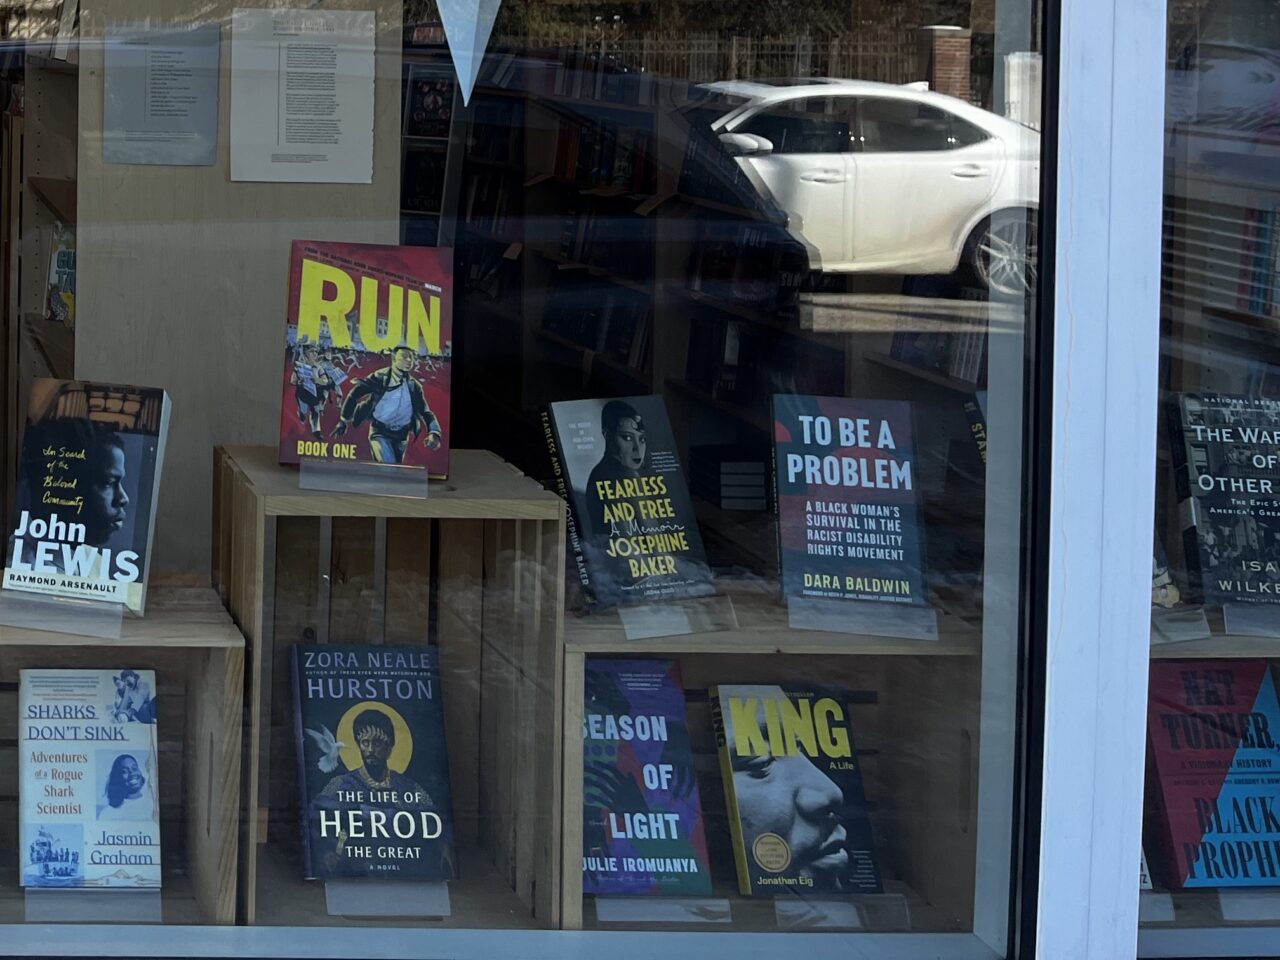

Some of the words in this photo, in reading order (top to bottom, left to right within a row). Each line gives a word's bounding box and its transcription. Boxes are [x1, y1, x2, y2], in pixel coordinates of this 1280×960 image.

[296, 258, 441, 355] RUN
[1204, 397, 1250, 405] NATIONAL
[798, 415, 832, 446] TO
[838, 417, 872, 448] BE
[877, 420, 897, 450] A
[1190, 425, 1234, 443] THE
[297, 440, 328, 457] BOOK
[332, 443, 357, 459] ONE
[1252, 454, 1278, 469] OF
[786, 453, 913, 491] PROBLEM
[596, 476, 668, 500] FEARLESS
[1198, 474, 1273, 494] OTHER
[603, 504, 635, 524] AND
[639, 498, 676, 520] FREE
[806, 500, 813, 512] A
[816, 501, 848, 514] BLACK
[851, 504, 901, 518] WOMAN'S
[14, 510, 86, 543] John
[551, 456, 561, 476] AND
[575, 556, 590, 586] BAKER
[626, 519, 685, 536] Memoir
[806, 516, 861, 530] SURVIVAL
[864, 517, 876, 530] IN
[879, 518, 902, 532] THE
[605, 532, 690, 558] JOSEPHINE
[807, 529, 843, 542] RACIST
[845, 531, 903, 547] DISABILITY
[807, 543, 844, 558] RIGHTS
[847, 546, 904, 561] MOVEMENT
[10, 539, 140, 584] LEWIS
[628, 556, 678, 578] BAKER
[9, 573, 57, 587] RAYMOND
[60, 579, 118, 593] ARSENAULT
[803, 573, 841, 590] DARA
[845, 576, 910, 595] BALDWIN
[304, 651, 359, 668] ZORA
[368, 652, 431, 669] NEALE
[307, 678, 433, 700] HURSTON
[1181, 670, 1235, 706] NAT
[28, 704, 96, 720] SHARKS
[711, 695, 727, 747] KING
[28, 726, 81, 741] DON'T
[84, 726, 125, 741] SINK
[727, 697, 853, 758] KING
[30, 751, 88, 765] Adventures
[829, 762, 837, 770] A
[838, 762, 855, 771] Life
[1236, 759, 1272, 769] HISTORY
[50, 768, 84, 783] Rogue
[642, 764, 674, 790] OF
[44, 784, 75, 798] Shark
[336, 790, 365, 802] THE
[369, 791, 399, 803] LIFE
[403, 791, 423, 803] OF
[36, 802, 83, 814] Scientist
[1193, 796, 1280, 834] BLACK
[319, 810, 443, 840] HEROD
[608, 812, 680, 840] LIGHT
[97, 830, 153, 846] Jasmin
[90, 850, 153, 865] Graham
[345, 845, 373, 858] THE
[377, 846, 422, 859] GREAT
[582, 857, 618, 872] JULIE
[622, 858, 698, 873] IROMUANYA
[756, 876, 798, 886] Jonathan
[798, 876, 815, 888] Eig
